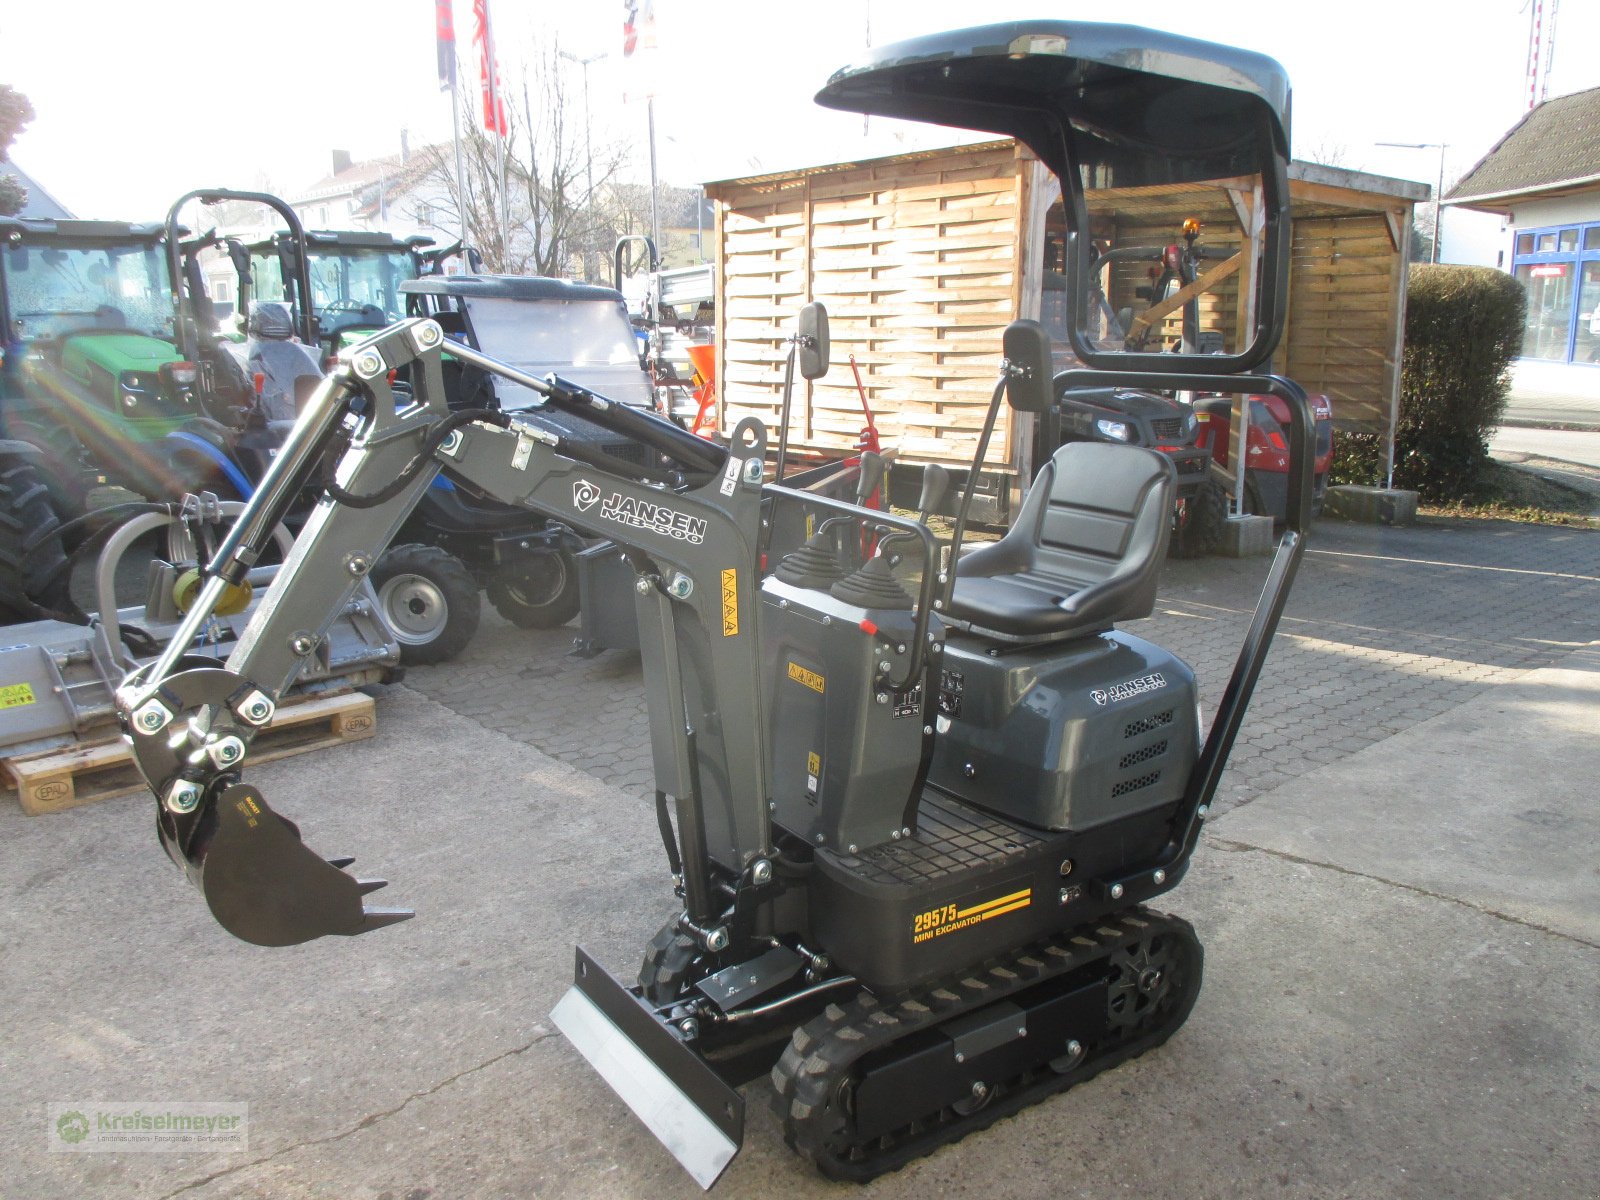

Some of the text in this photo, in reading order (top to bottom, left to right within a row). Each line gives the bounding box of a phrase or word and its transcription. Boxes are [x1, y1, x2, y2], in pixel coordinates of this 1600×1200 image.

[600, 507, 704, 544] MB-500
[602, 493, 707, 537] JANSEN
[1108, 672, 1165, 698] JANSEN
[350, 718, 370, 730] EPAL
[40, 783, 67, 799] EPAL
[913, 913, 983, 944] MINI EXCAVATOR
[914, 903, 957, 933] 29575
